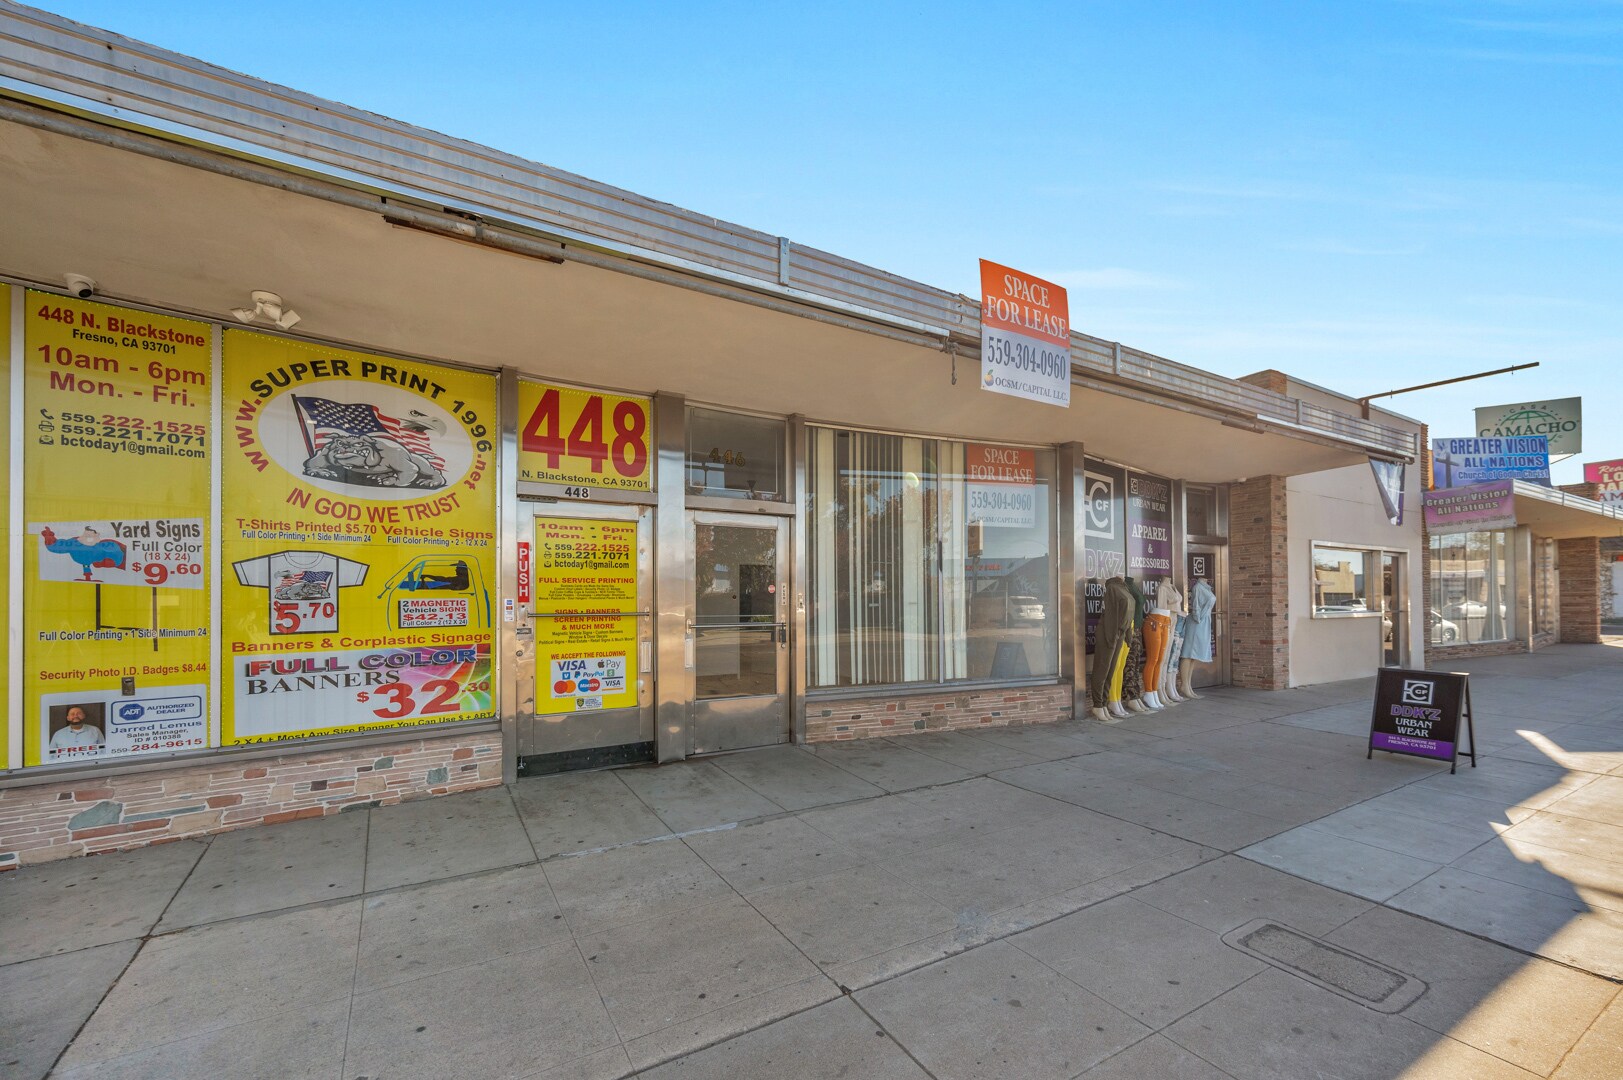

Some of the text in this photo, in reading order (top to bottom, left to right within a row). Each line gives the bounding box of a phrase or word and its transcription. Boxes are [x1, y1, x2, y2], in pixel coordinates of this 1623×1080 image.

[1004, 274, 1050, 308] SPACE
[986, 294, 1066, 339] FOR LEASE
[38, 305, 205, 346] 448 N. Blackstone
[72, 329, 176, 354] Fresno, CA 93701
[38, 344, 205, 385] 10am 6pm
[988, 336, 1066, 380] 559-304-0960
[361, 361, 447, 400] PRINT
[50, 371, 195, 407] Mon. Fri.
[61, 412, 206, 435] 559.222.1525
[1480, 420, 1577, 438] CAMACHO
[61, 424, 205, 447] 559.221.7071
[522, 388, 647, 478] 448
[61, 435, 206, 458] bctoday1@gmail.com
[1450, 438, 1546, 454] GREATER VISION
[709, 448, 745, 467] 446
[984, 448, 1020, 464] SPACE
[1464, 456, 1544, 468] ALL NATIONS
[522, 470, 648, 488] N. Blackstone, CA 93701
[970, 464, 1033, 483] FOR LEASE
[1458, 471, 1487, 480] Church
[565, 487, 589, 498] 448
[1426, 489, 1508, 506] Greater Vision
[286, 487, 460, 523] IN GOD WE TRUST
[972, 492, 1032, 511] 559-304-0960
[1132, 497, 1166, 512] URBAN WEAR
[1437, 502, 1499, 515] All Nations
[111, 520, 200, 542] Yard Signs
[236, 518, 377, 534] T-Shirts Printed $5.70
[381, 525, 493, 540] Vehicle Signs
[1132, 524, 1168, 542] APPAREL
[242, 530, 372, 543] Full Color Printing Side Minimum 24
[388, 536, 450, 547] Full Color Printing
[546, 532, 585, 540] Mon.
[132, 541, 202, 552] Full Color
[555, 543, 630, 552] 559.222.1525
[1148, 544, 1154, 554] &
[144, 552, 160, 562] (18
[175, 552, 190, 562] 24)
[555, 552, 629, 560] 559.221.7071
[1130, 557, 1170, 570] ACCESSORIES
[519, 548, 528, 596] PUSH
[554, 560, 630, 570] bctoday1@gmail.com
[132, 562, 201, 585] $9.60
[1084, 583, 1106, 596] URBA
[402, 600, 409, 608] 2
[1086, 600, 1106, 614] WEA
[403, 613, 466, 621] $42.13
[39, 628, 207, 642] Full Color Printing Side Minimum 24
[232, 632, 492, 652] Banners & Corplastic Signage
[596, 650, 626, 658] FOLLOWING
[246, 648, 478, 677] FULL COLOR
[557, 660, 621, 671] VISA Pay
[40, 663, 206, 680] Security Photo I.D. Badges $8.44
[246, 670, 401, 696] BANNERS
[124, 702, 195, 716] ADT AUTHORIZED
[1390, 704, 1442, 721] DDK'Z
[111, 720, 202, 734] Jarred Lemus
[1396, 718, 1432, 729] URBAN
[1397, 726, 1429, 738] WEAR
[57, 745, 98, 754] FREE
